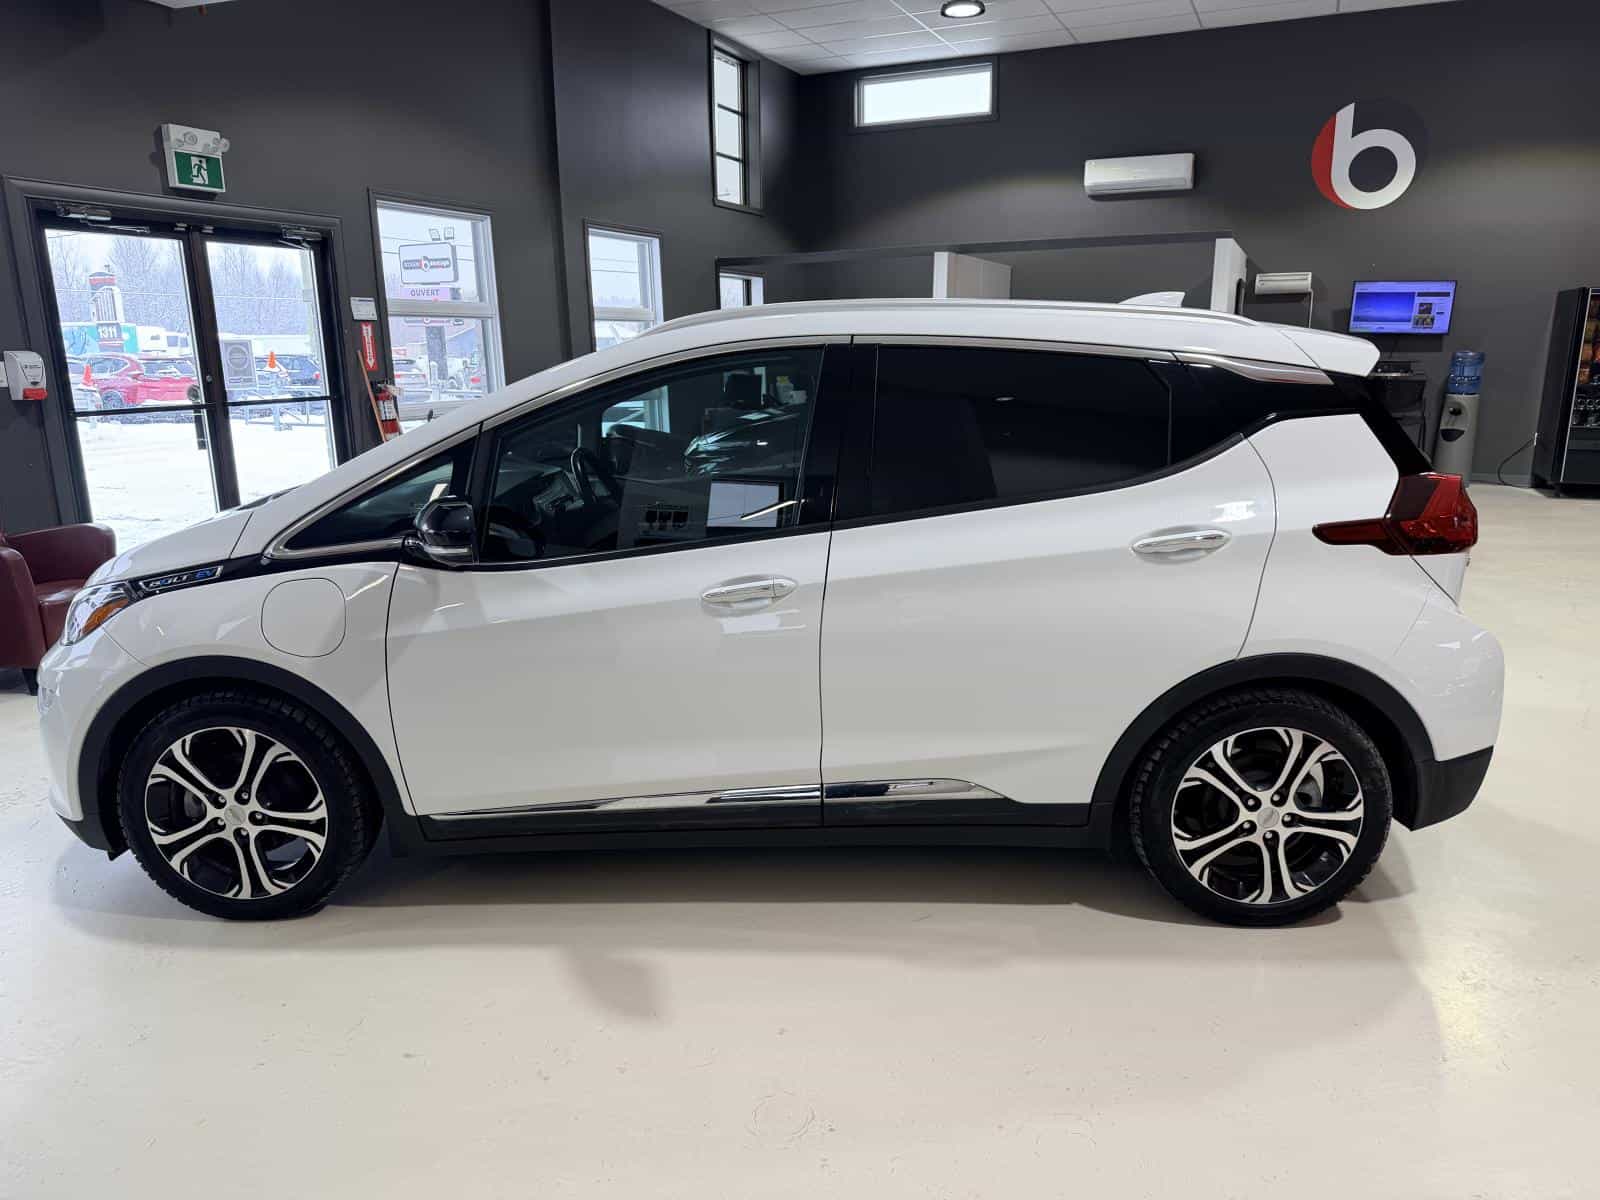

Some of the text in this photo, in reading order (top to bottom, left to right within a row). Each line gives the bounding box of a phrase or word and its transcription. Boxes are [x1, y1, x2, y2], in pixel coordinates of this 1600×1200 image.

[1330, 102, 1417, 210] b
[410, 287, 440, 297] OUVERT
[98, 326, 117, 338] 1311
[195, 568, 217, 579] EV
